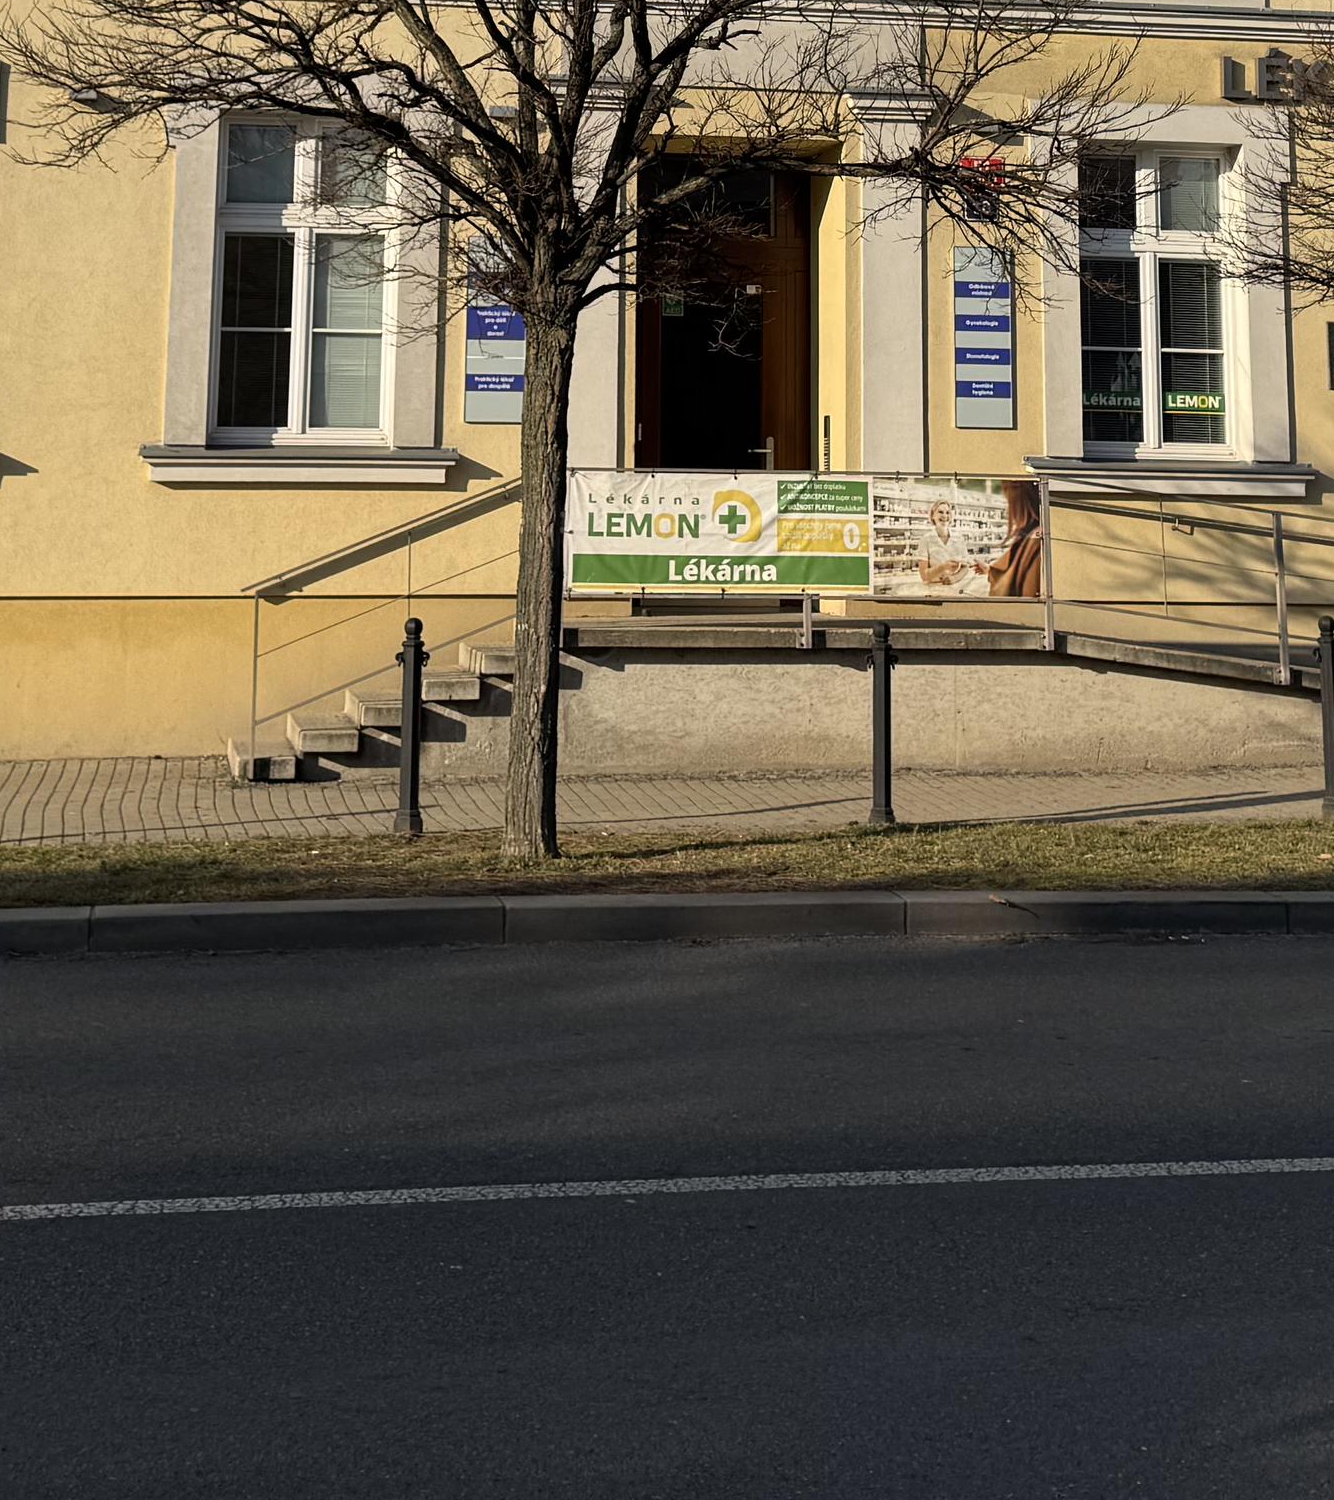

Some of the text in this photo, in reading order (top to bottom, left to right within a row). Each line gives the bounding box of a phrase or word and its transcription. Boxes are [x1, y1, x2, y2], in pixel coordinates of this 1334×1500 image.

[1083, 393, 1220, 409] Lékárna LEMON
[588, 492, 700, 506] Lékárna
[668, 557, 778, 583] Lékárna
